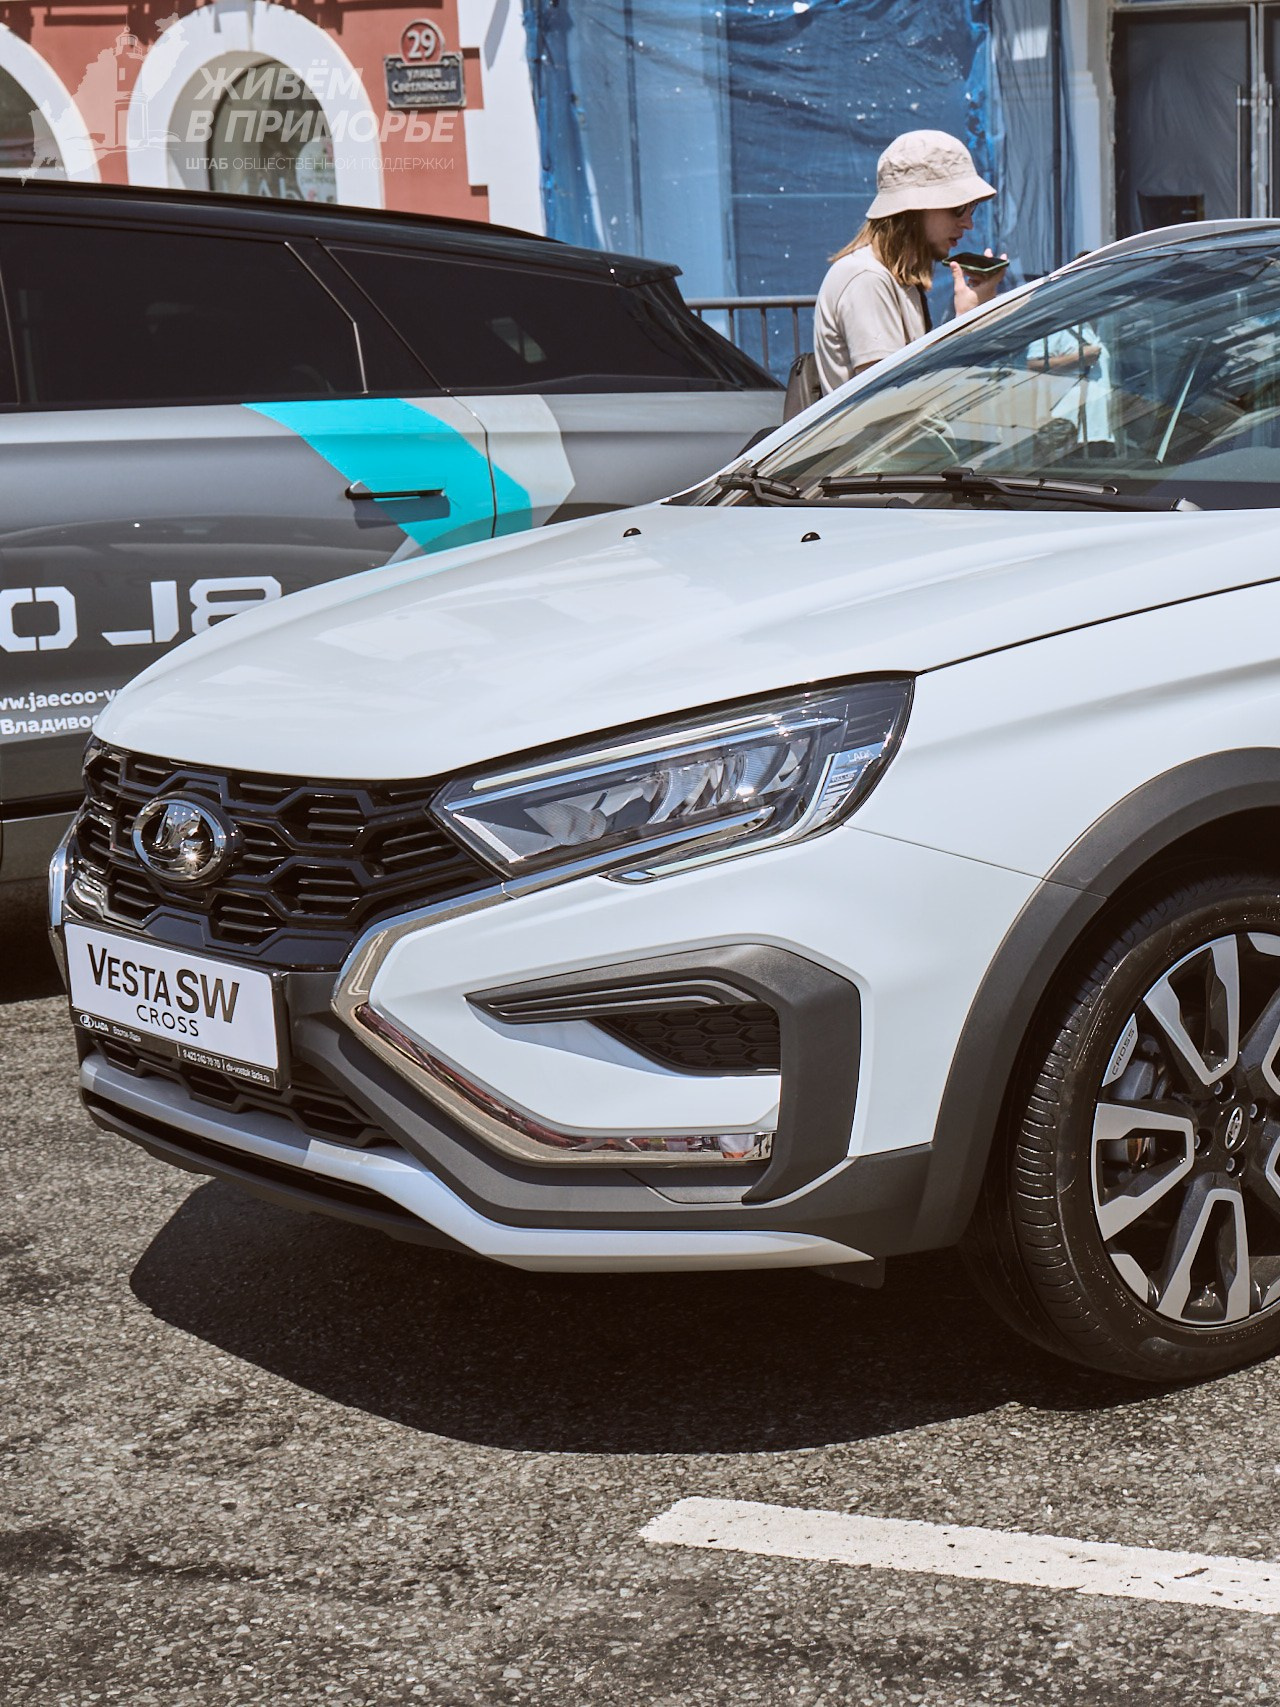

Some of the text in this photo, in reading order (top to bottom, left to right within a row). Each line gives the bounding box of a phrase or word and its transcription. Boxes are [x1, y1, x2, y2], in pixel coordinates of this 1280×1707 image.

[406, 29, 436, 58] 29
[87, 943, 240, 1024] VESTA SW
[136, 1004, 199, 1037] CROSS
[1111, 1028, 1135, 1076] CROSS
